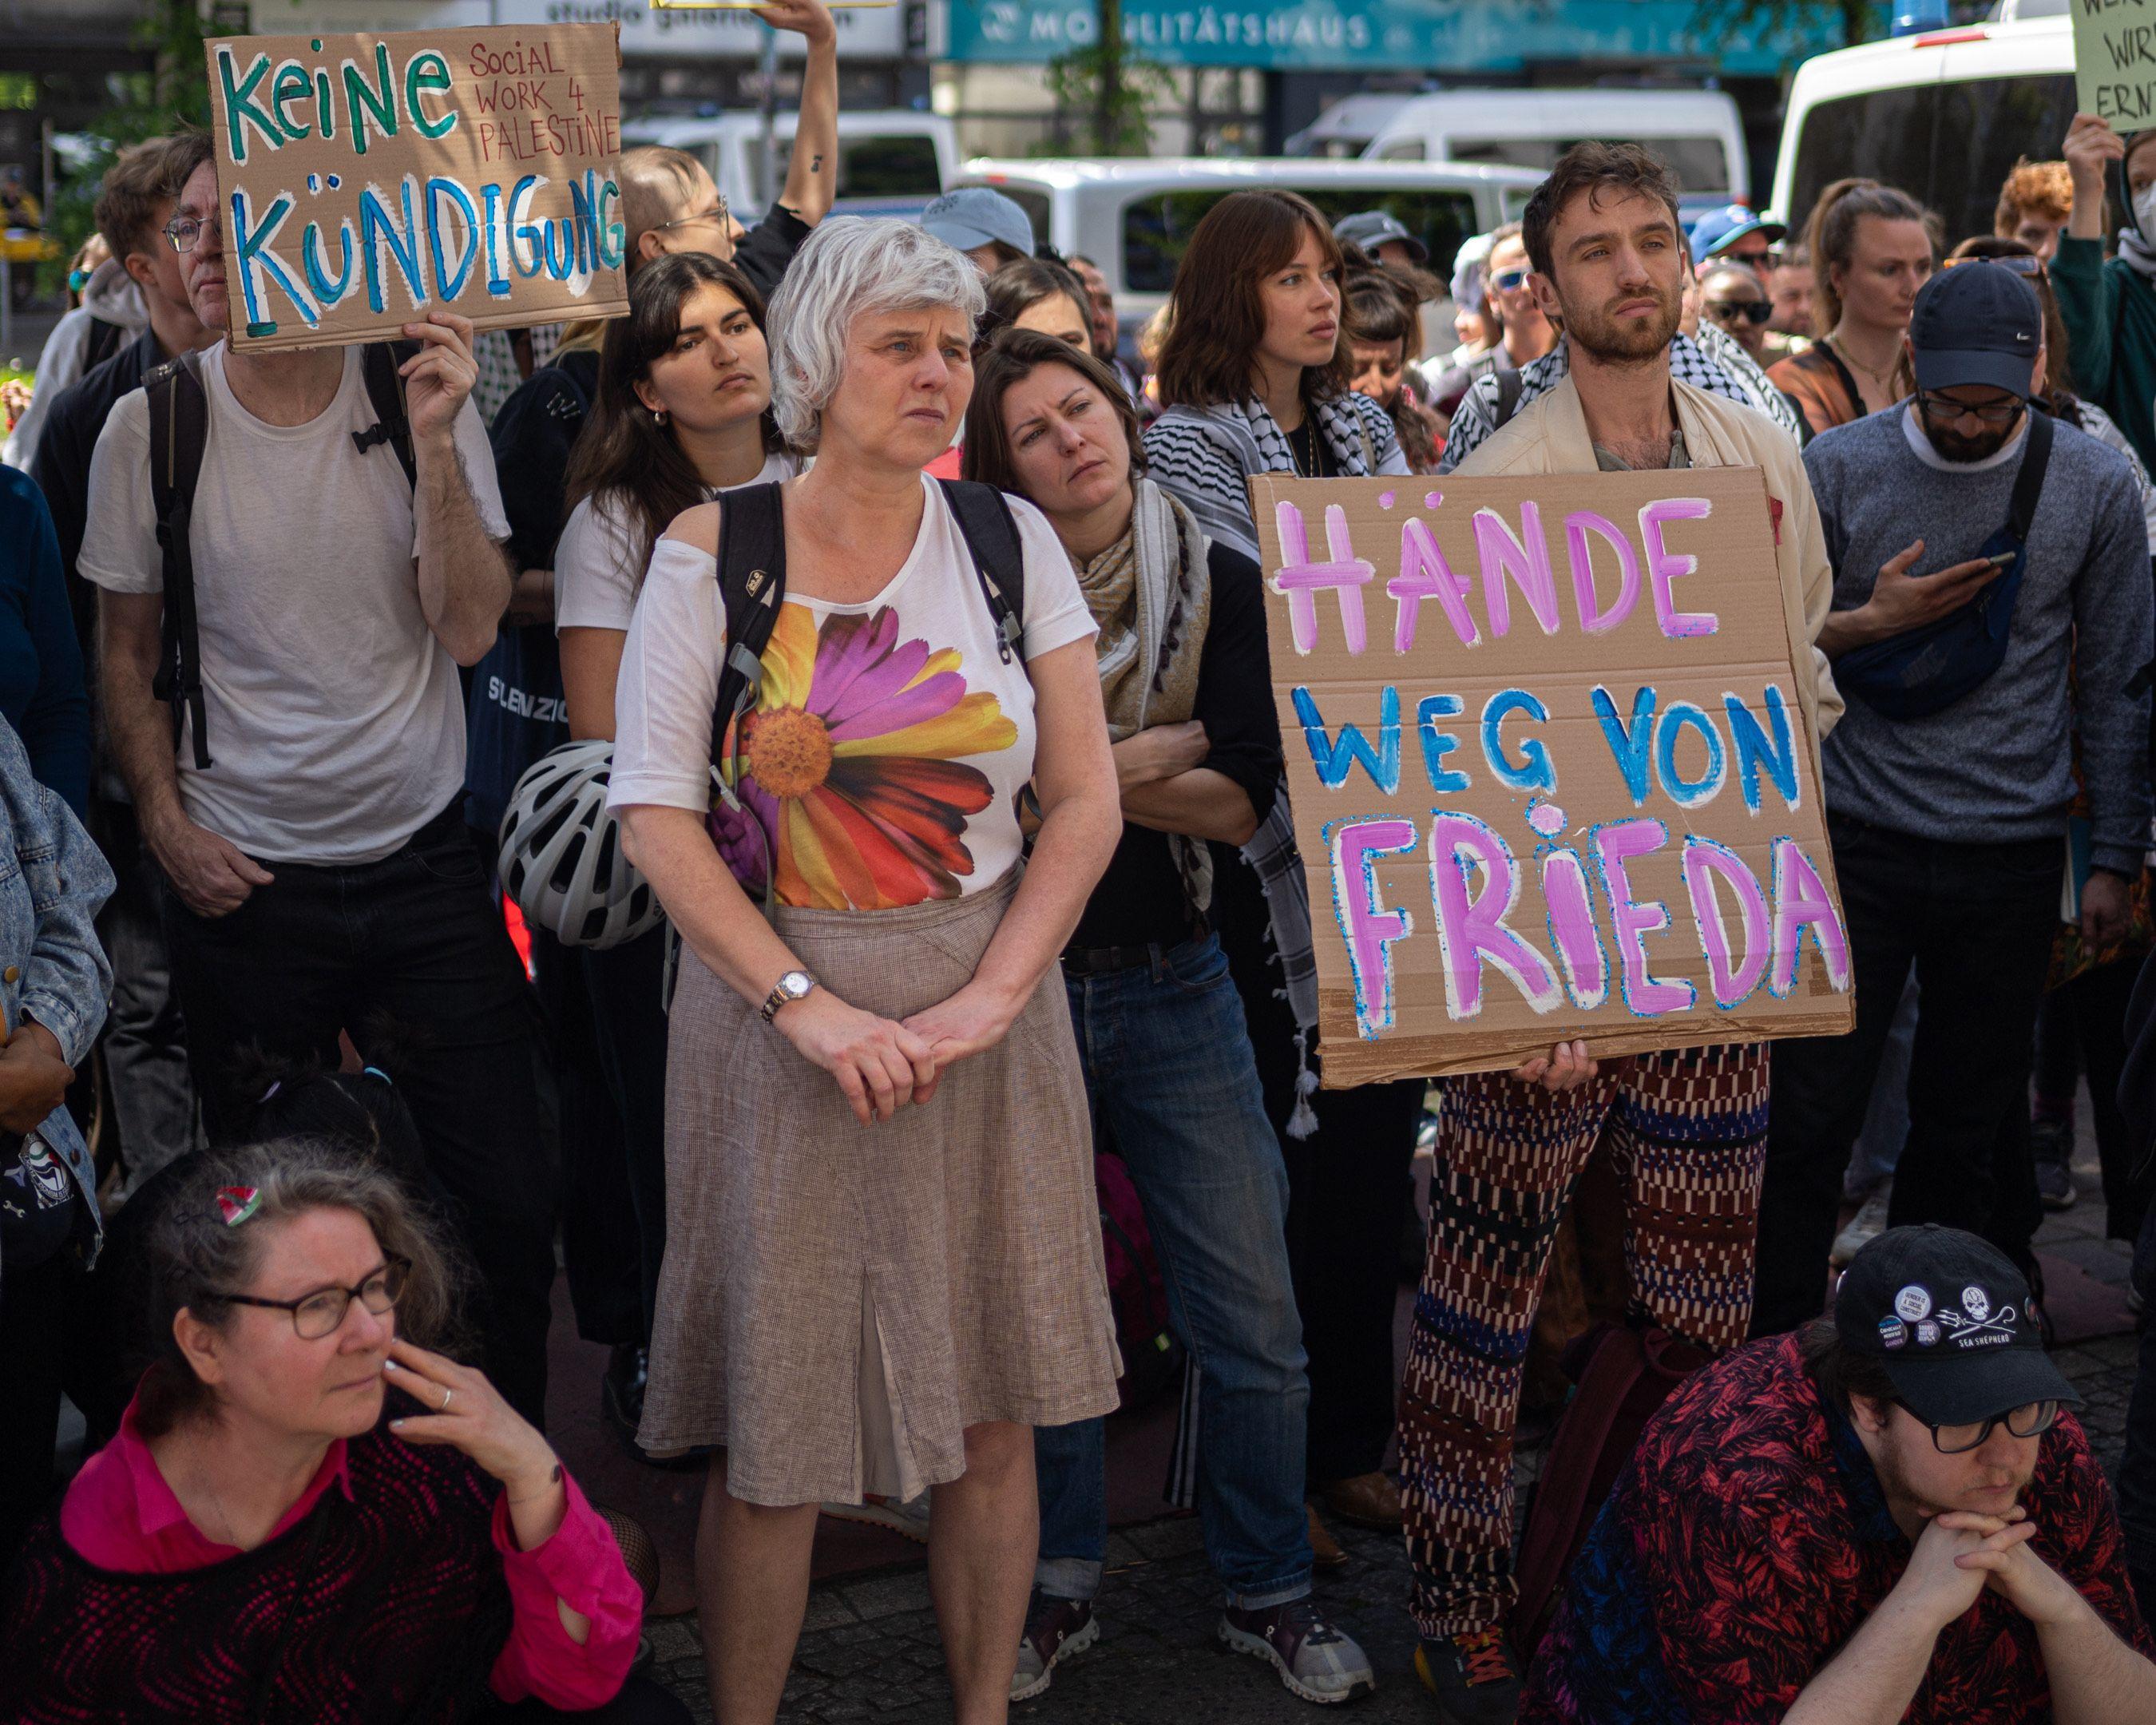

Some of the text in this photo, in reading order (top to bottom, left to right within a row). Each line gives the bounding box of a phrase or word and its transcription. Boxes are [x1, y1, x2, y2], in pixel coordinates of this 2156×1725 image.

[1028, 6, 1371, 49] MOILITÄTSHAUS
[475, 77, 584, 113] WORK 4
[2097, 81, 2156, 118] ERN
[230, 167, 625, 338] KÜNDIGUNG
[1268, 490, 1719, 656] HÄNDE
[1291, 683, 1800, 816] WEG VON
[1959, 1334, 2009, 1347] SEA SHEPHERD
